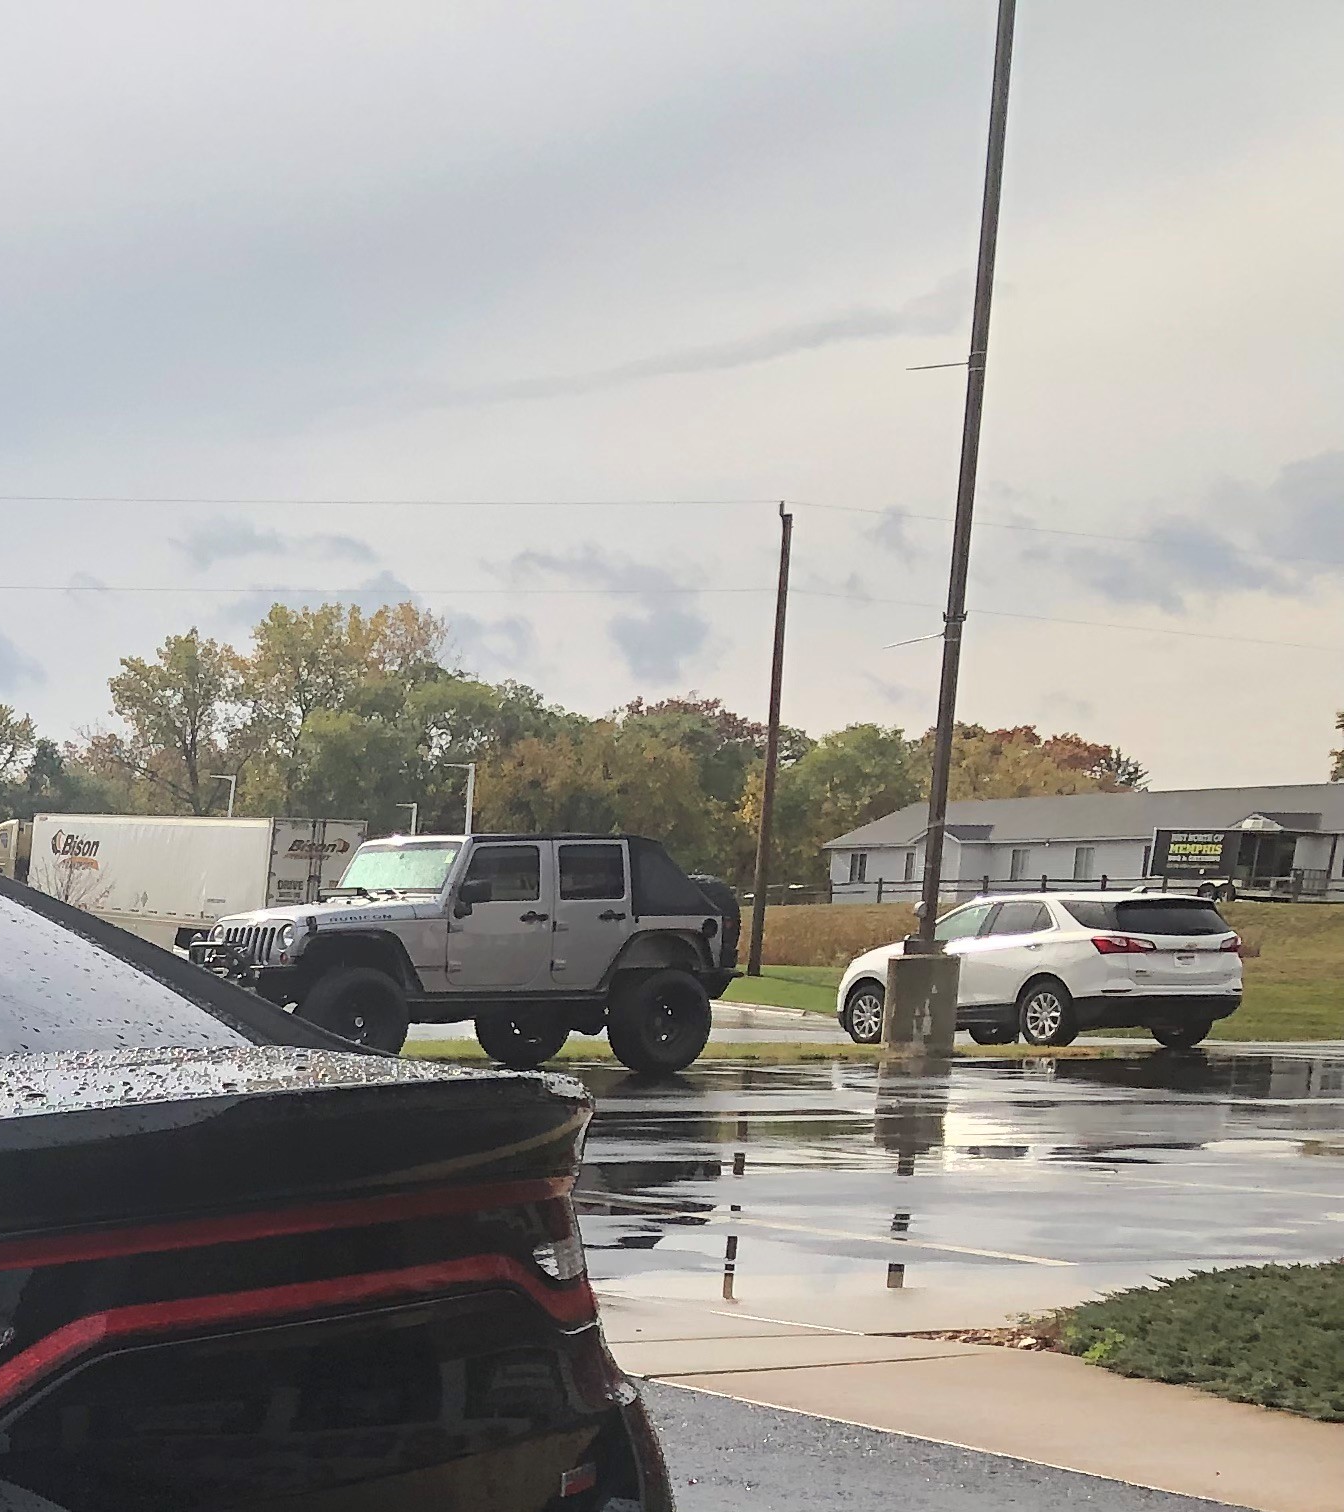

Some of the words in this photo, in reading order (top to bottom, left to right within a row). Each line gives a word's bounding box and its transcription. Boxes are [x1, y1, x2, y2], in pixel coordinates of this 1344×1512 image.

[61, 834, 100, 857] Bison
[288, 839, 338, 853] Bison
[1168, 843, 1223, 855] MEMPHIS
